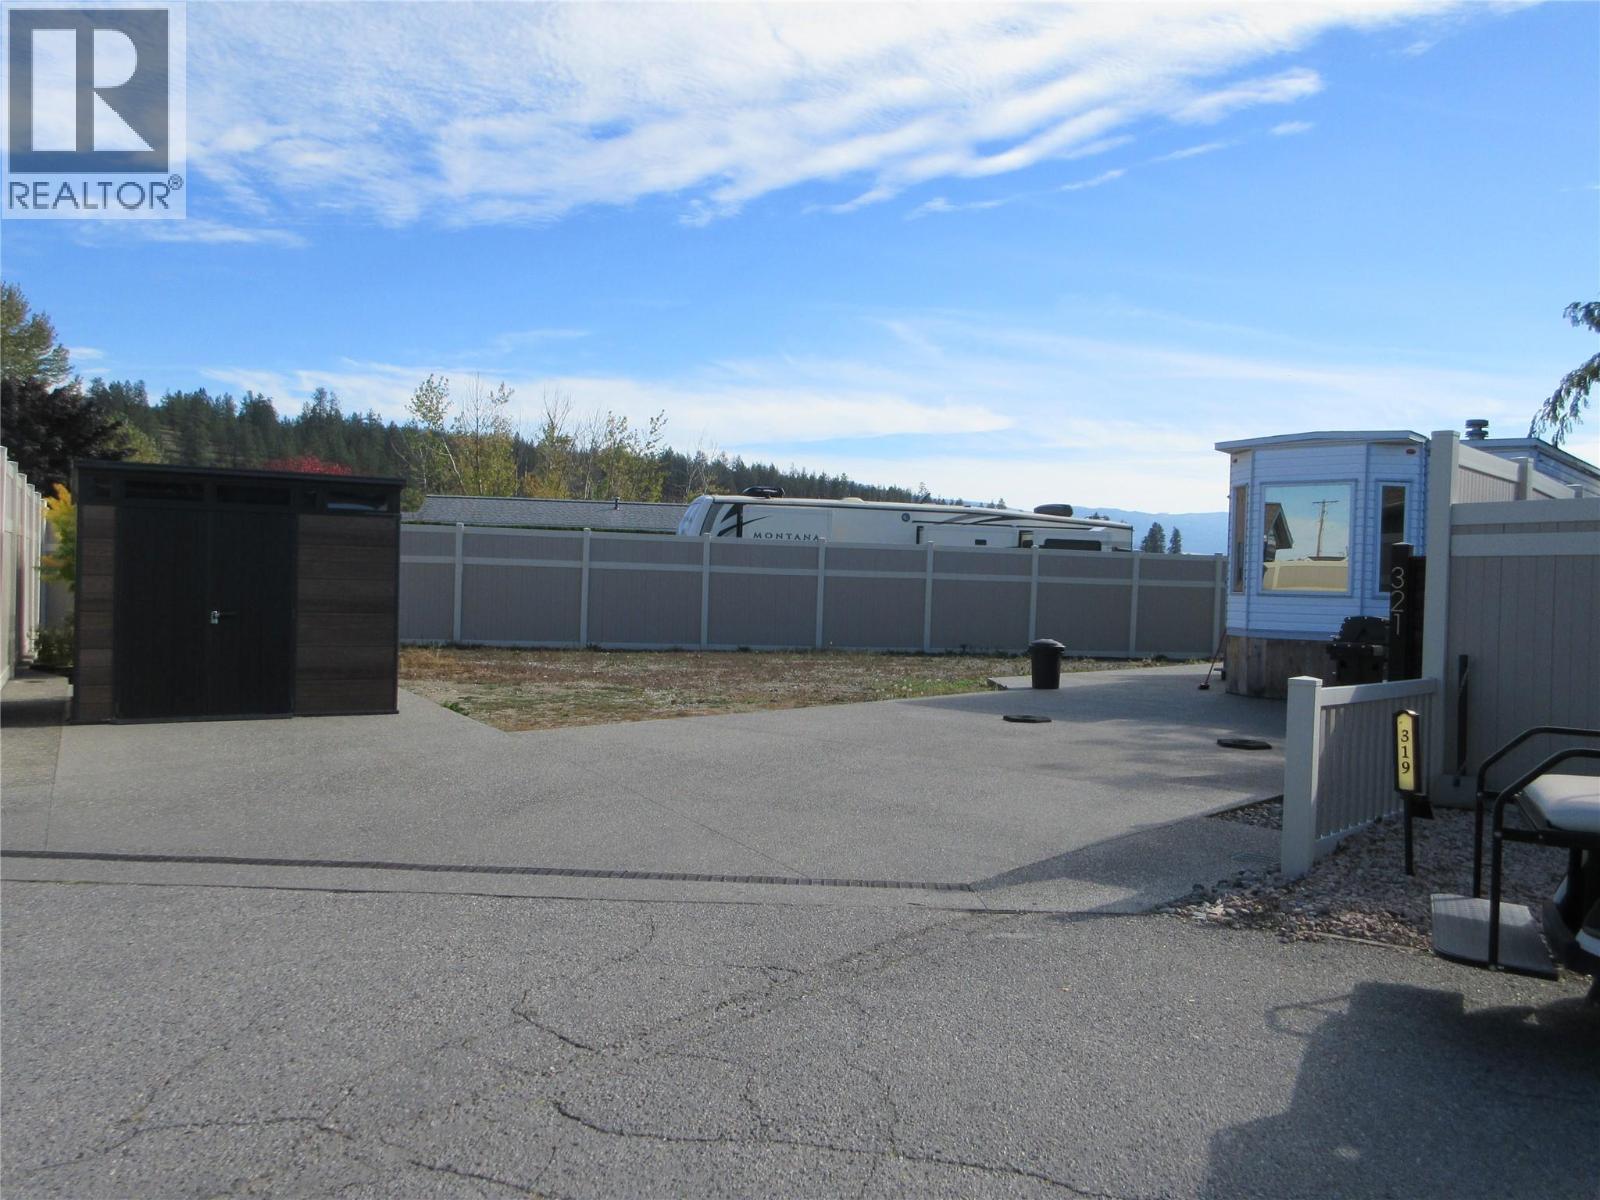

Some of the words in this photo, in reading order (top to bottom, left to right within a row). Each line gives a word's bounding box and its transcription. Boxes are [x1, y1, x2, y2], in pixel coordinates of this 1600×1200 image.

[753, 531, 820, 541] MONTANA
[1391, 566, 1405, 635] 321
[1400, 729, 1411, 774] 319
